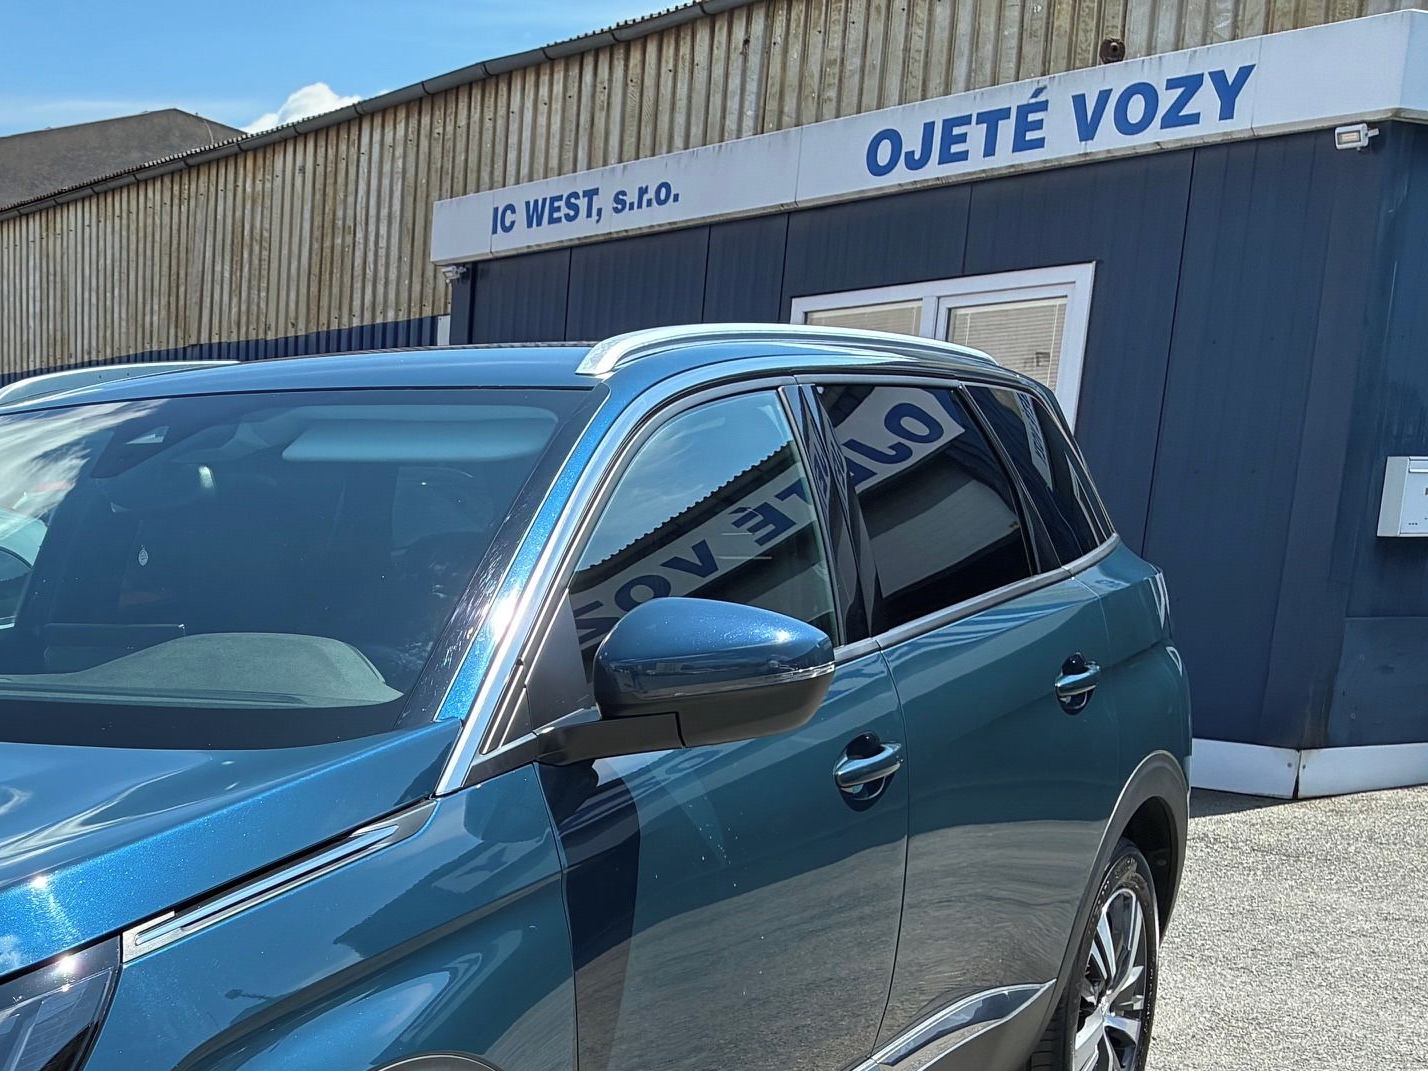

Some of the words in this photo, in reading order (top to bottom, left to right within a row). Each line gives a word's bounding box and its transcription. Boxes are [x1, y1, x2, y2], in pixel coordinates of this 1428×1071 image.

[866, 86, 1049, 177] OJETÉ
[1071, 63, 1257, 143] VOZY
[491, 203, 517, 235] IC
[524, 186, 603, 229] WEST,
[612, 180, 680, 214] s.r.o.
